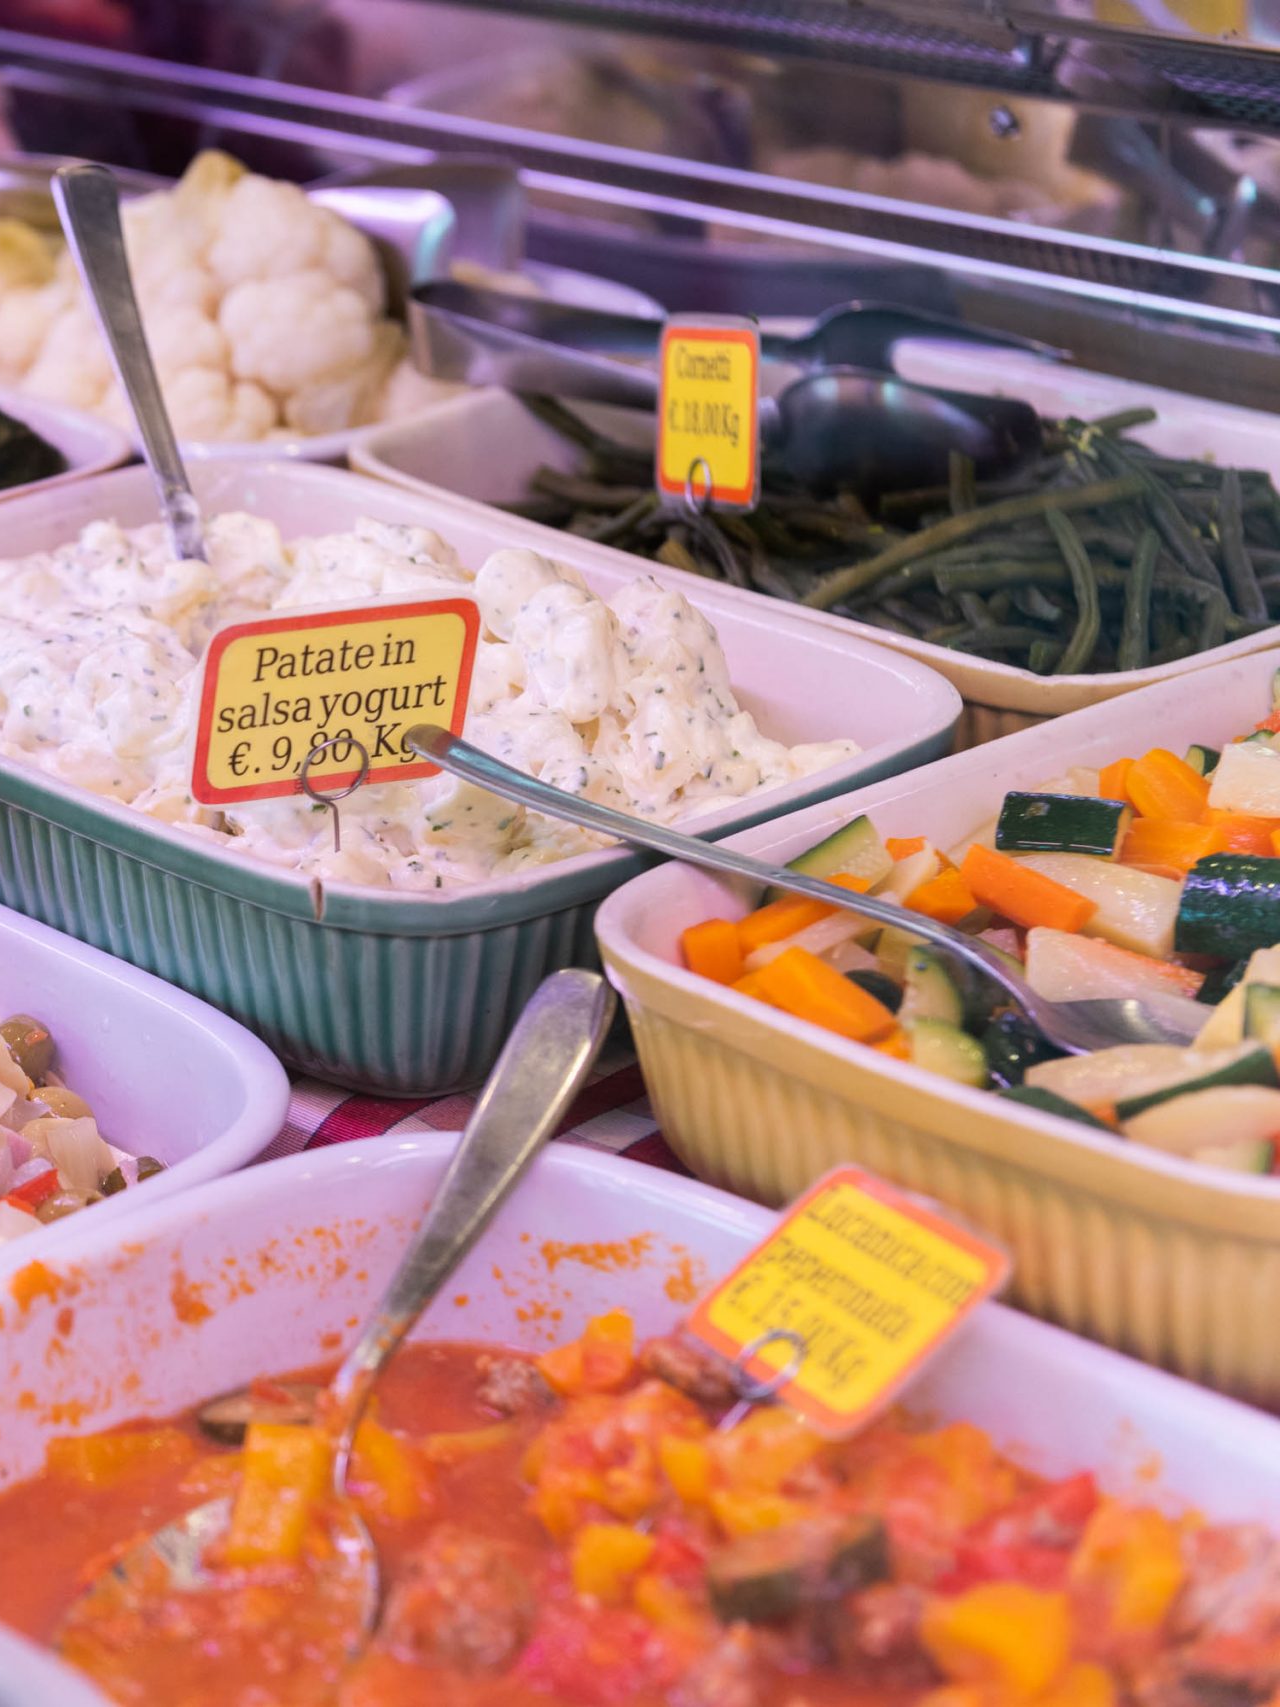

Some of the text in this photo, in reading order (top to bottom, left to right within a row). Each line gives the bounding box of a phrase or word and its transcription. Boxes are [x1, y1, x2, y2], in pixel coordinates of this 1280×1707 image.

[252, 633, 416, 682] Patate in
[217, 675, 447, 733] salsa yogurt
